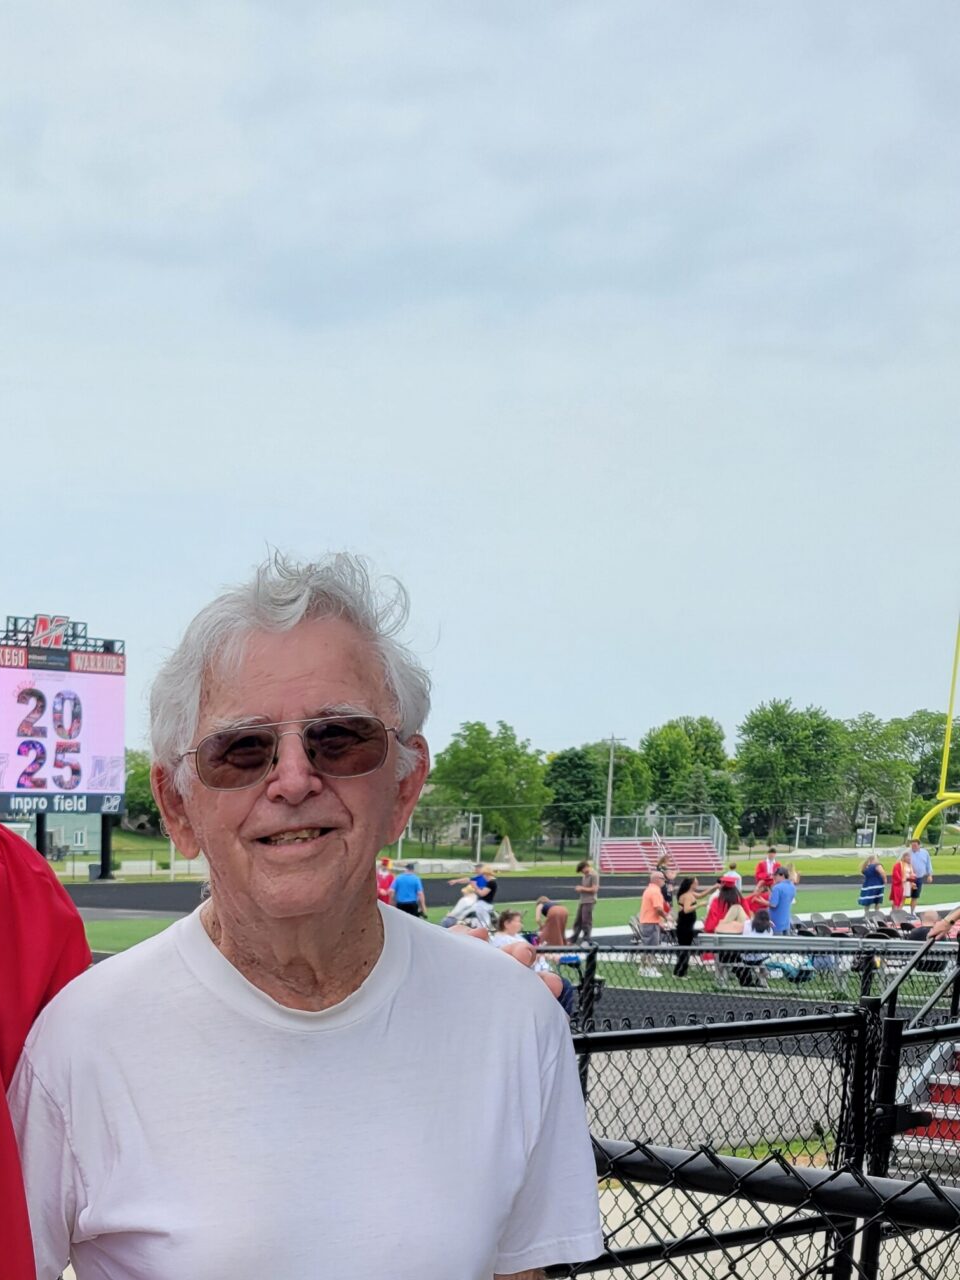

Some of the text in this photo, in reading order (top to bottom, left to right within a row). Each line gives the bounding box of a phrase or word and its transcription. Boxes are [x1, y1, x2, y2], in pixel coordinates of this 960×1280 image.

[74, 654, 124, 673] WARRIORS
[16, 688, 82, 739] 20
[16, 740, 82, 790] 25
[10, 795, 87, 813] inpro field
